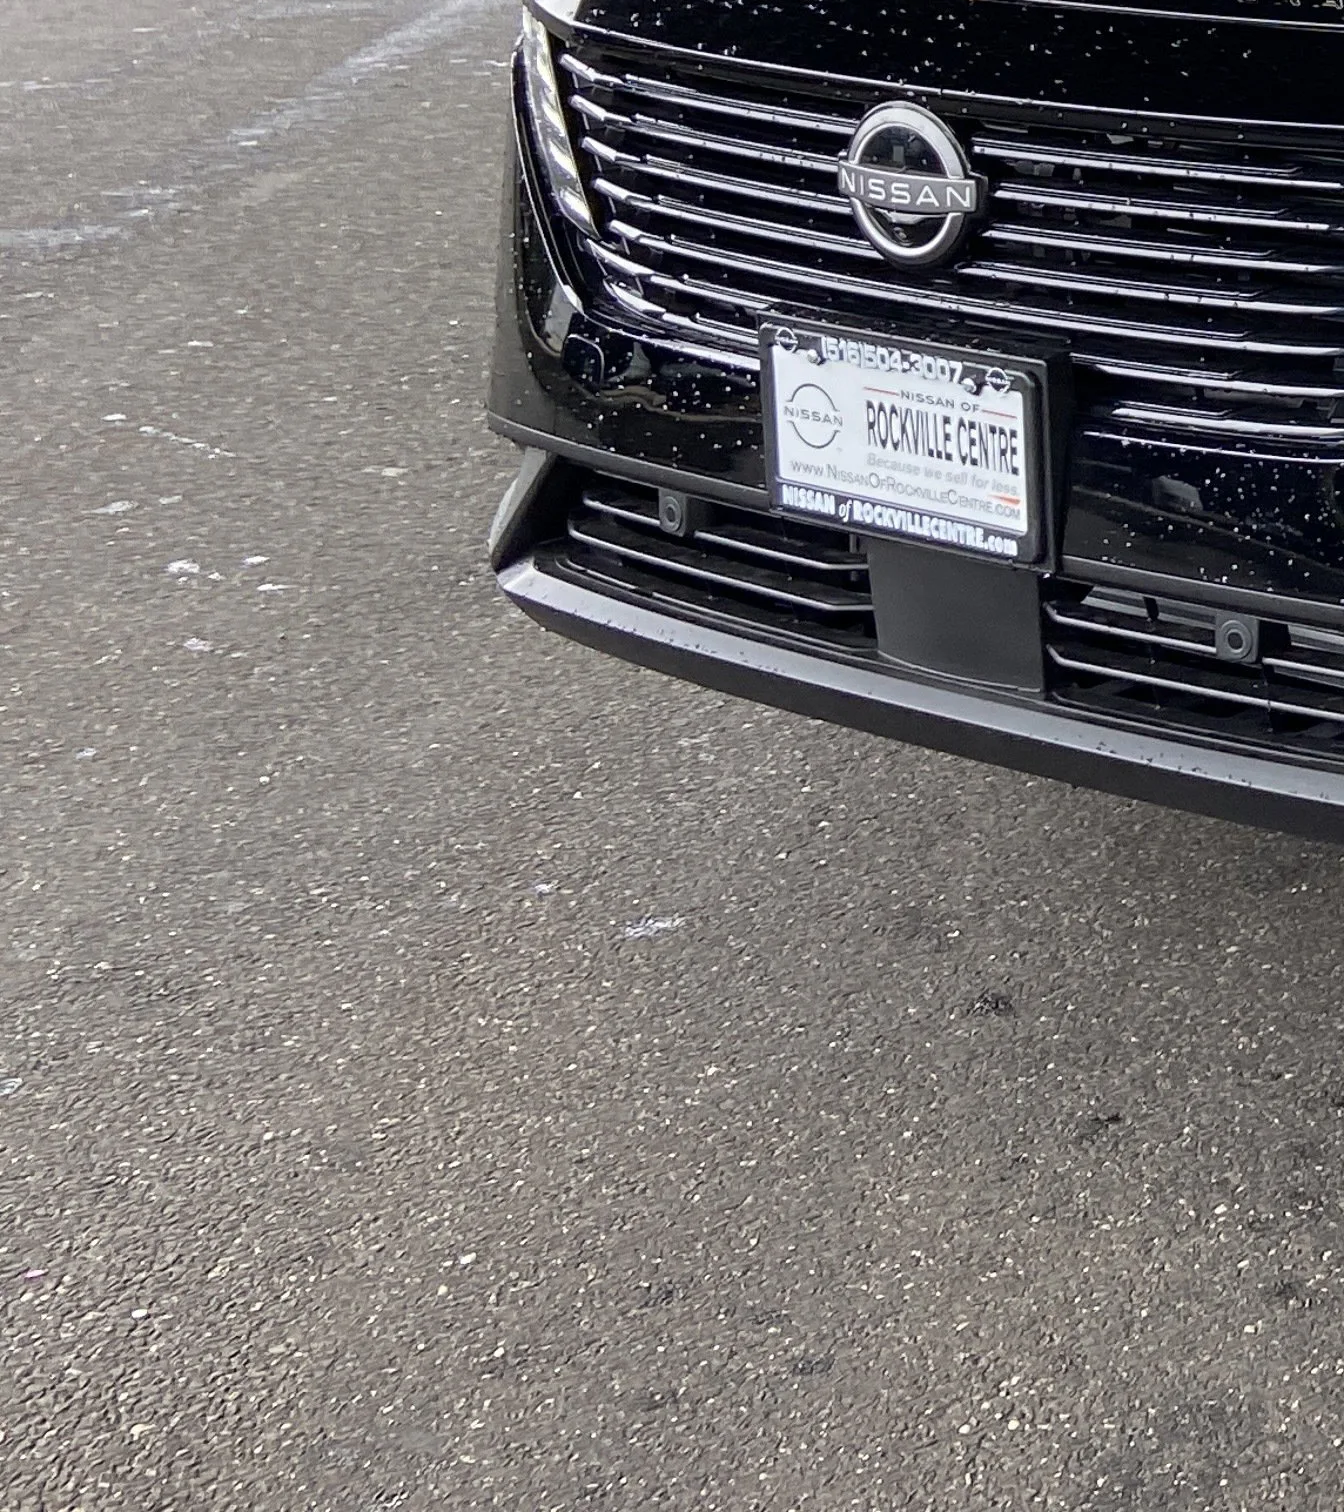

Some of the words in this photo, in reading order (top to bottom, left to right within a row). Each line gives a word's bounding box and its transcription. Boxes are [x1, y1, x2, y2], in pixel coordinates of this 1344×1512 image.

[840, 167, 971, 208] NISSAN
[783, 406, 843, 426] NISSAN
[900, 390, 955, 408] NISSAN
[960, 402, 980, 412] OF
[866, 400, 953, 462] ROCKVILLE
[957, 417, 1019, 476] CENTRE
[867, 452, 920, 476] Because
[924, 467, 942, 480] we
[945, 471, 968, 484] sell
[971, 474, 989, 489] for
[782, 484, 836, 516] NISSAN
[838, 499, 852, 523] of
[852, 500, 1018, 556] ROCKVILLECENTRE.com
